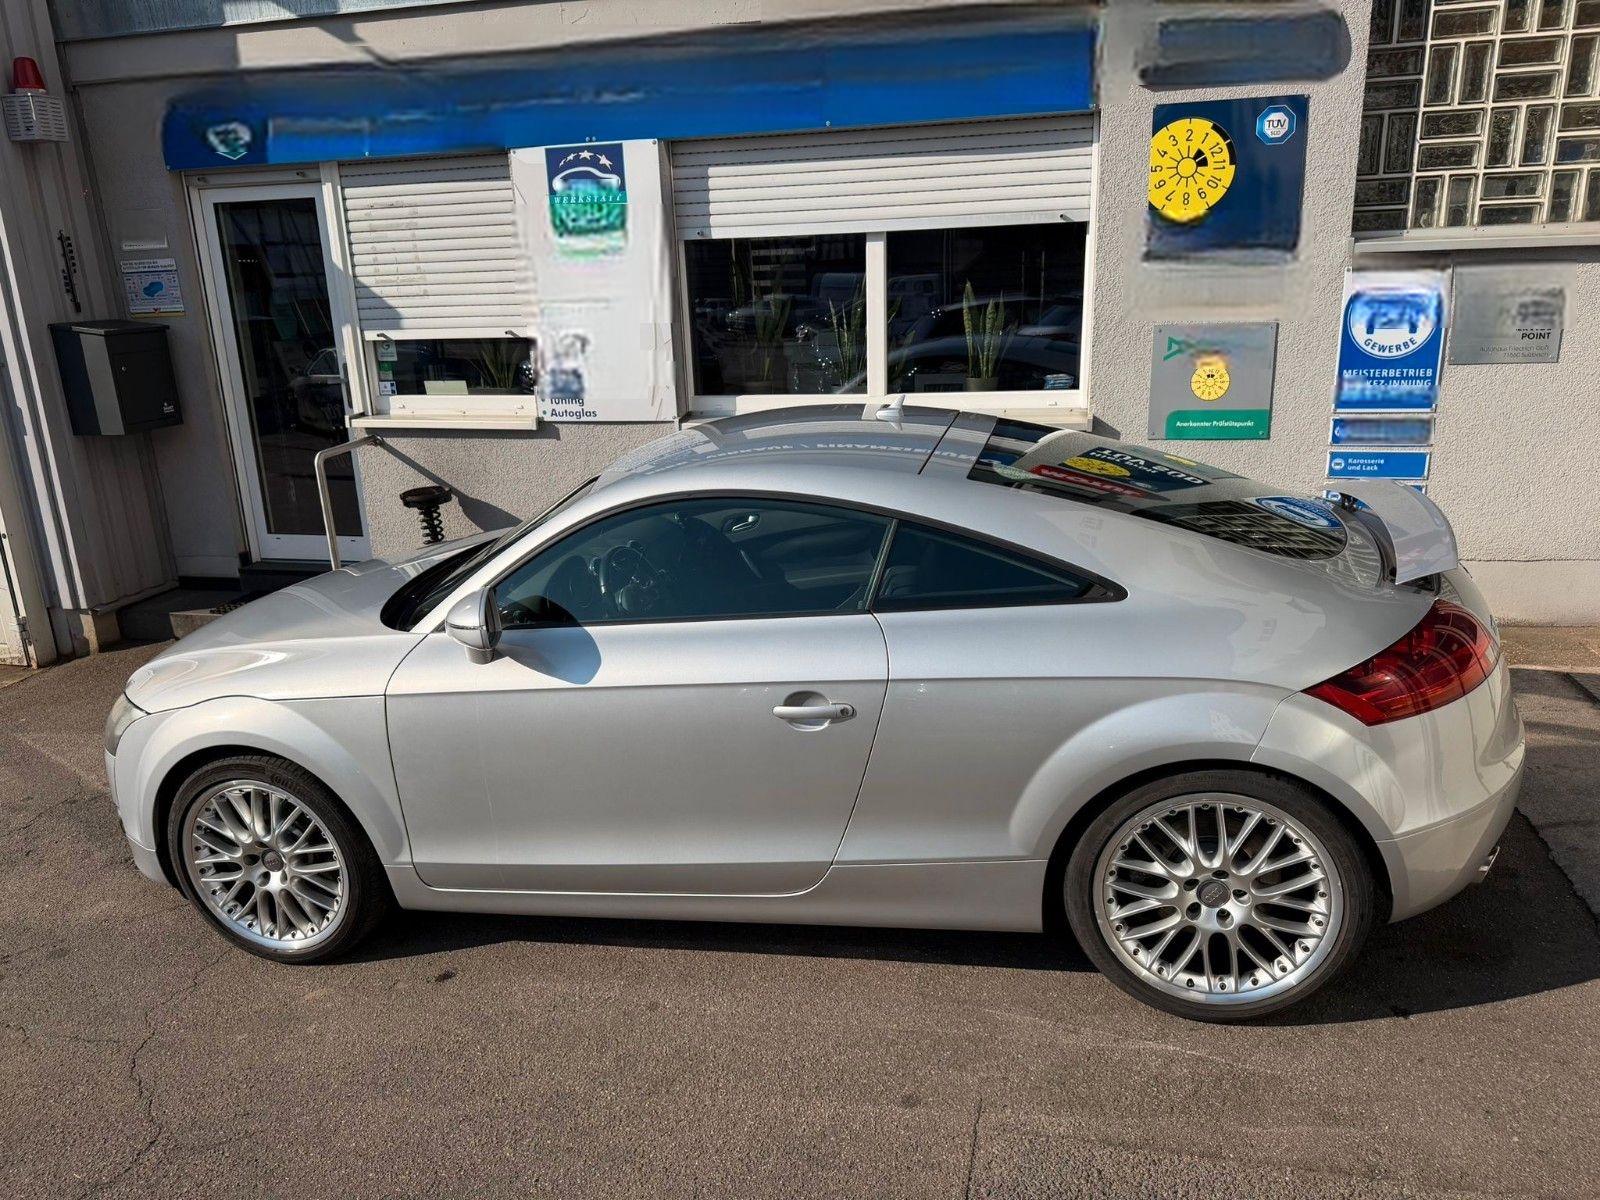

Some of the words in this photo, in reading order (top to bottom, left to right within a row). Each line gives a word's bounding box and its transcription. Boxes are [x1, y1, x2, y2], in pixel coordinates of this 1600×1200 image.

[1266, 119, 1287, 128] TÜV
[1168, 135, 1179, 147] 3
[1186, 129, 1194, 142] 2
[1201, 132, 1209, 144] 1
[1157, 147, 1168, 158] 4
[1208, 142, 1224, 158] 12
[1213, 159, 1226, 171] 11
[1154, 179, 1167, 190] 6
[1206, 175, 1222, 189] 10
[1165, 190, 1176, 202] 7
[1182, 192, 1190, 206] 8
[1197, 187, 1207, 200] 9
[1521, 332, 1552, 341] POINT
[1363, 337, 1418, 354] GEWERBE
[1342, 368, 1433, 378] MEISTERBETRIEB
[551, 408, 597, 419] Autoglas
